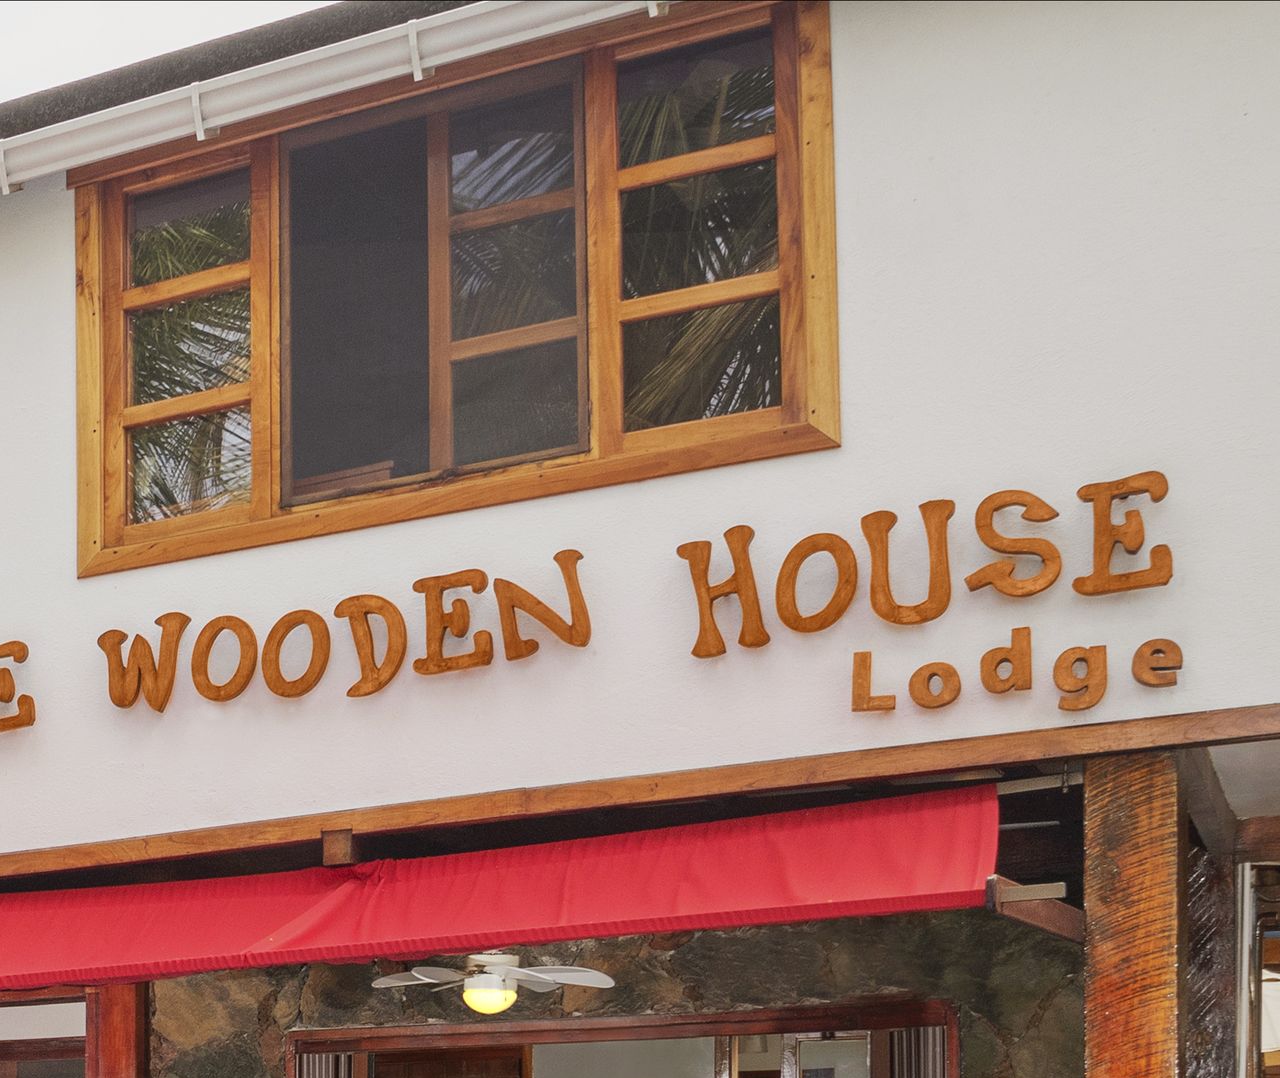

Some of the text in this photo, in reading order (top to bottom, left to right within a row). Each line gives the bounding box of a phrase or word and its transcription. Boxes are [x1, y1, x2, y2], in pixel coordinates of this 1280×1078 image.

[98, 550, 591, 713] WOODEN
[677, 471, 1173, 659] HOUSE
[852, 627, 1183, 714] Lodge
